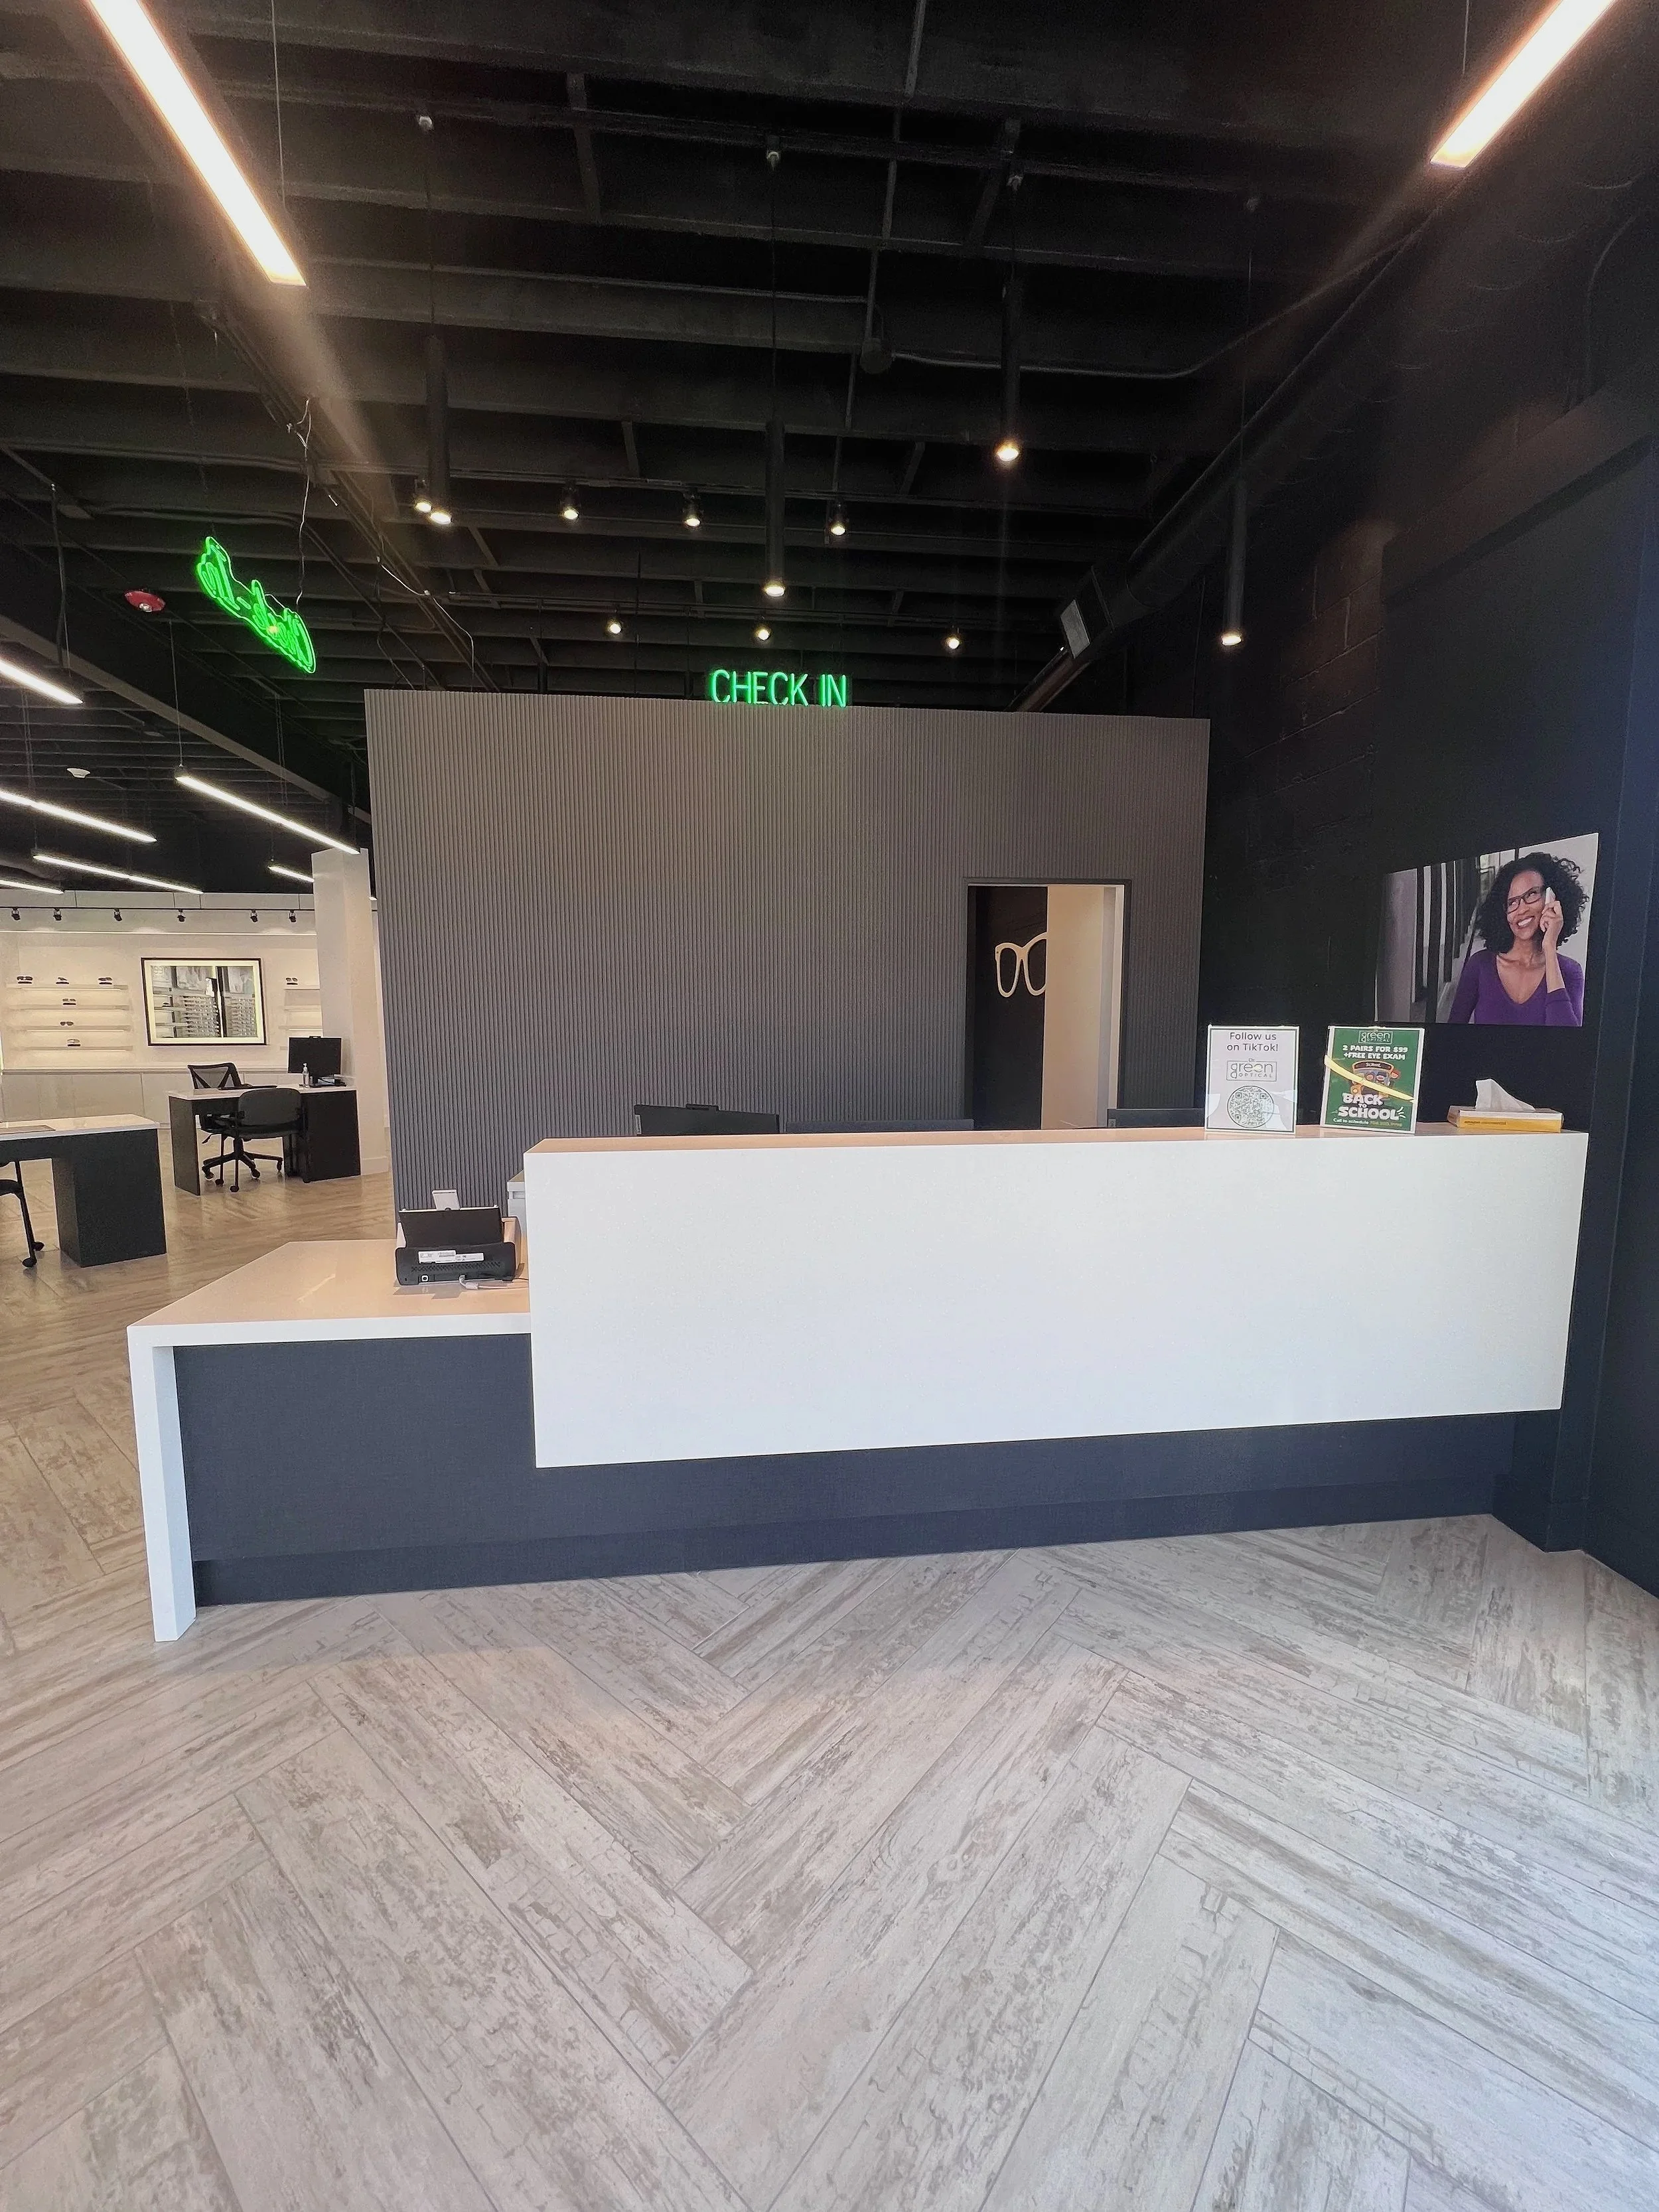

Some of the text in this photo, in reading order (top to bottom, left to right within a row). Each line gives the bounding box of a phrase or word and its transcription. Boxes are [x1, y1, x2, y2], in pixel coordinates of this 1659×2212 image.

[712, 669, 846, 707] CHECK IN
[1361, 1031, 1390, 1043] green
[1230, 1063, 1273, 1078] green
[1342, 1092, 1384, 1106] BACK
[1338, 1106, 1400, 1121] SCHOOL
